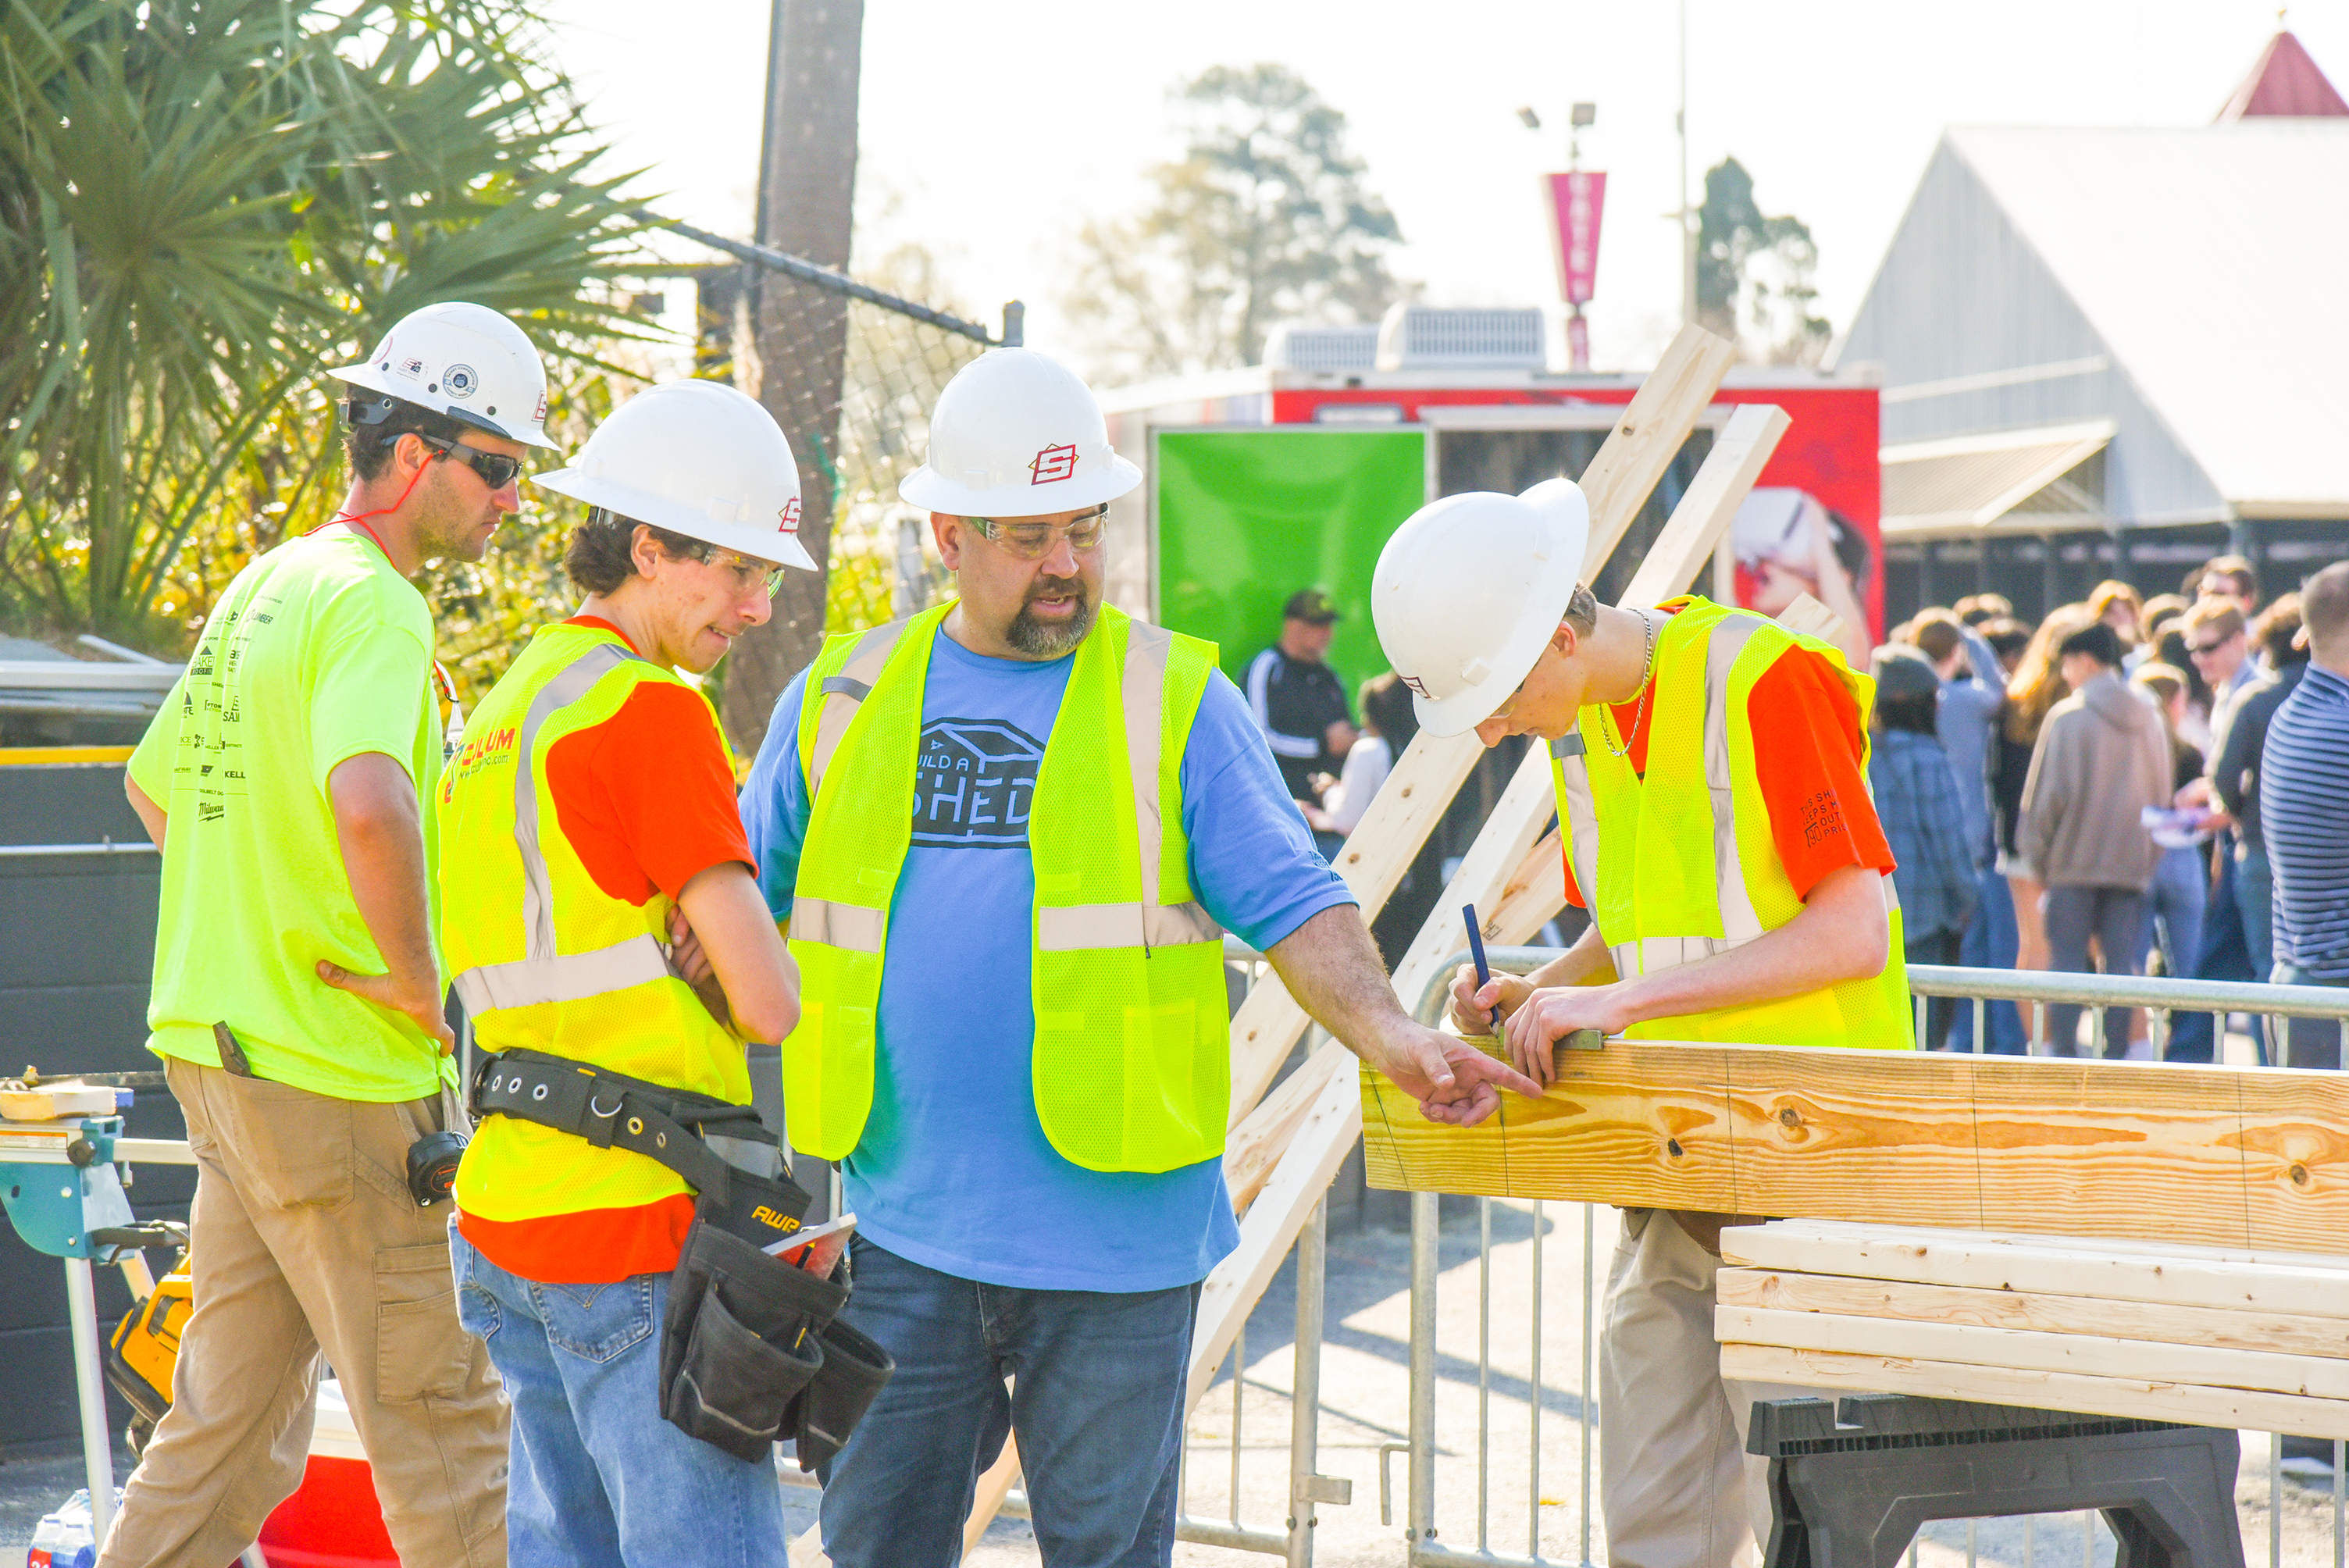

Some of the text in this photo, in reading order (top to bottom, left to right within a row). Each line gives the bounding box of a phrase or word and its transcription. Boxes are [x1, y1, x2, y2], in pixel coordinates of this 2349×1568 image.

[956, 757, 970, 772] A
[1820, 812, 1841, 826] OUT
[751, 1205, 800, 1233] AWP
